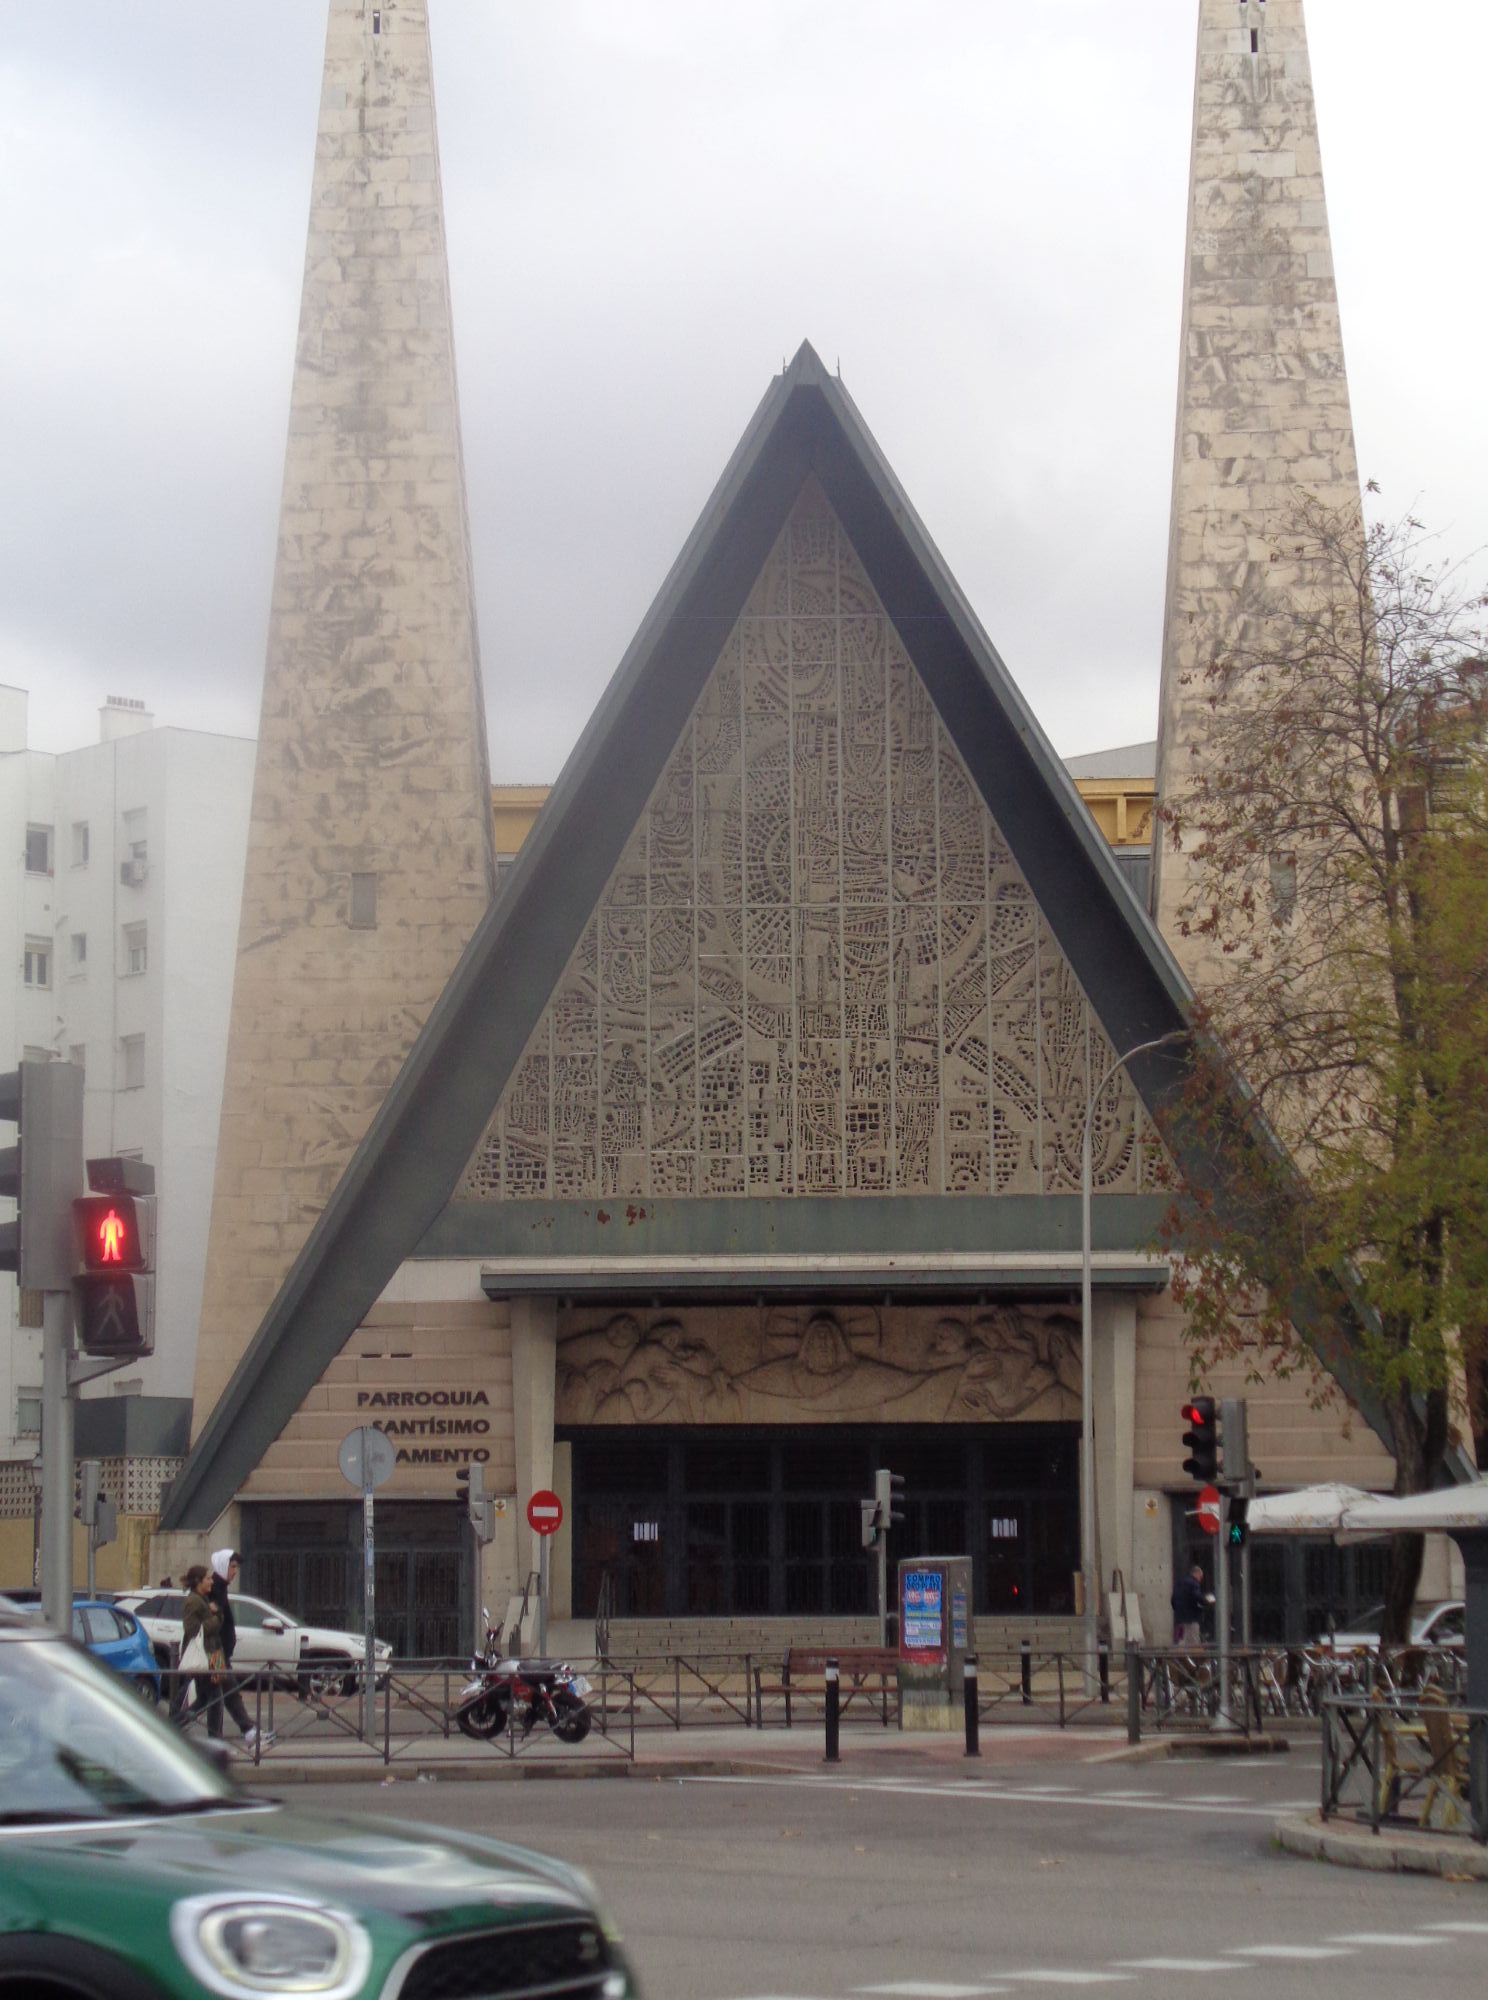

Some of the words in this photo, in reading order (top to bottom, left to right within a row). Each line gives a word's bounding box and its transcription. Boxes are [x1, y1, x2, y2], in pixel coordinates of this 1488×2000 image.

[357, 1391, 490, 1406] PARROQUIA
[372, 1416, 490, 1434] SANTÍSIMO
[396, 1448, 490, 1463] AMENTO
[907, 1574, 941, 1583] COMPRO
